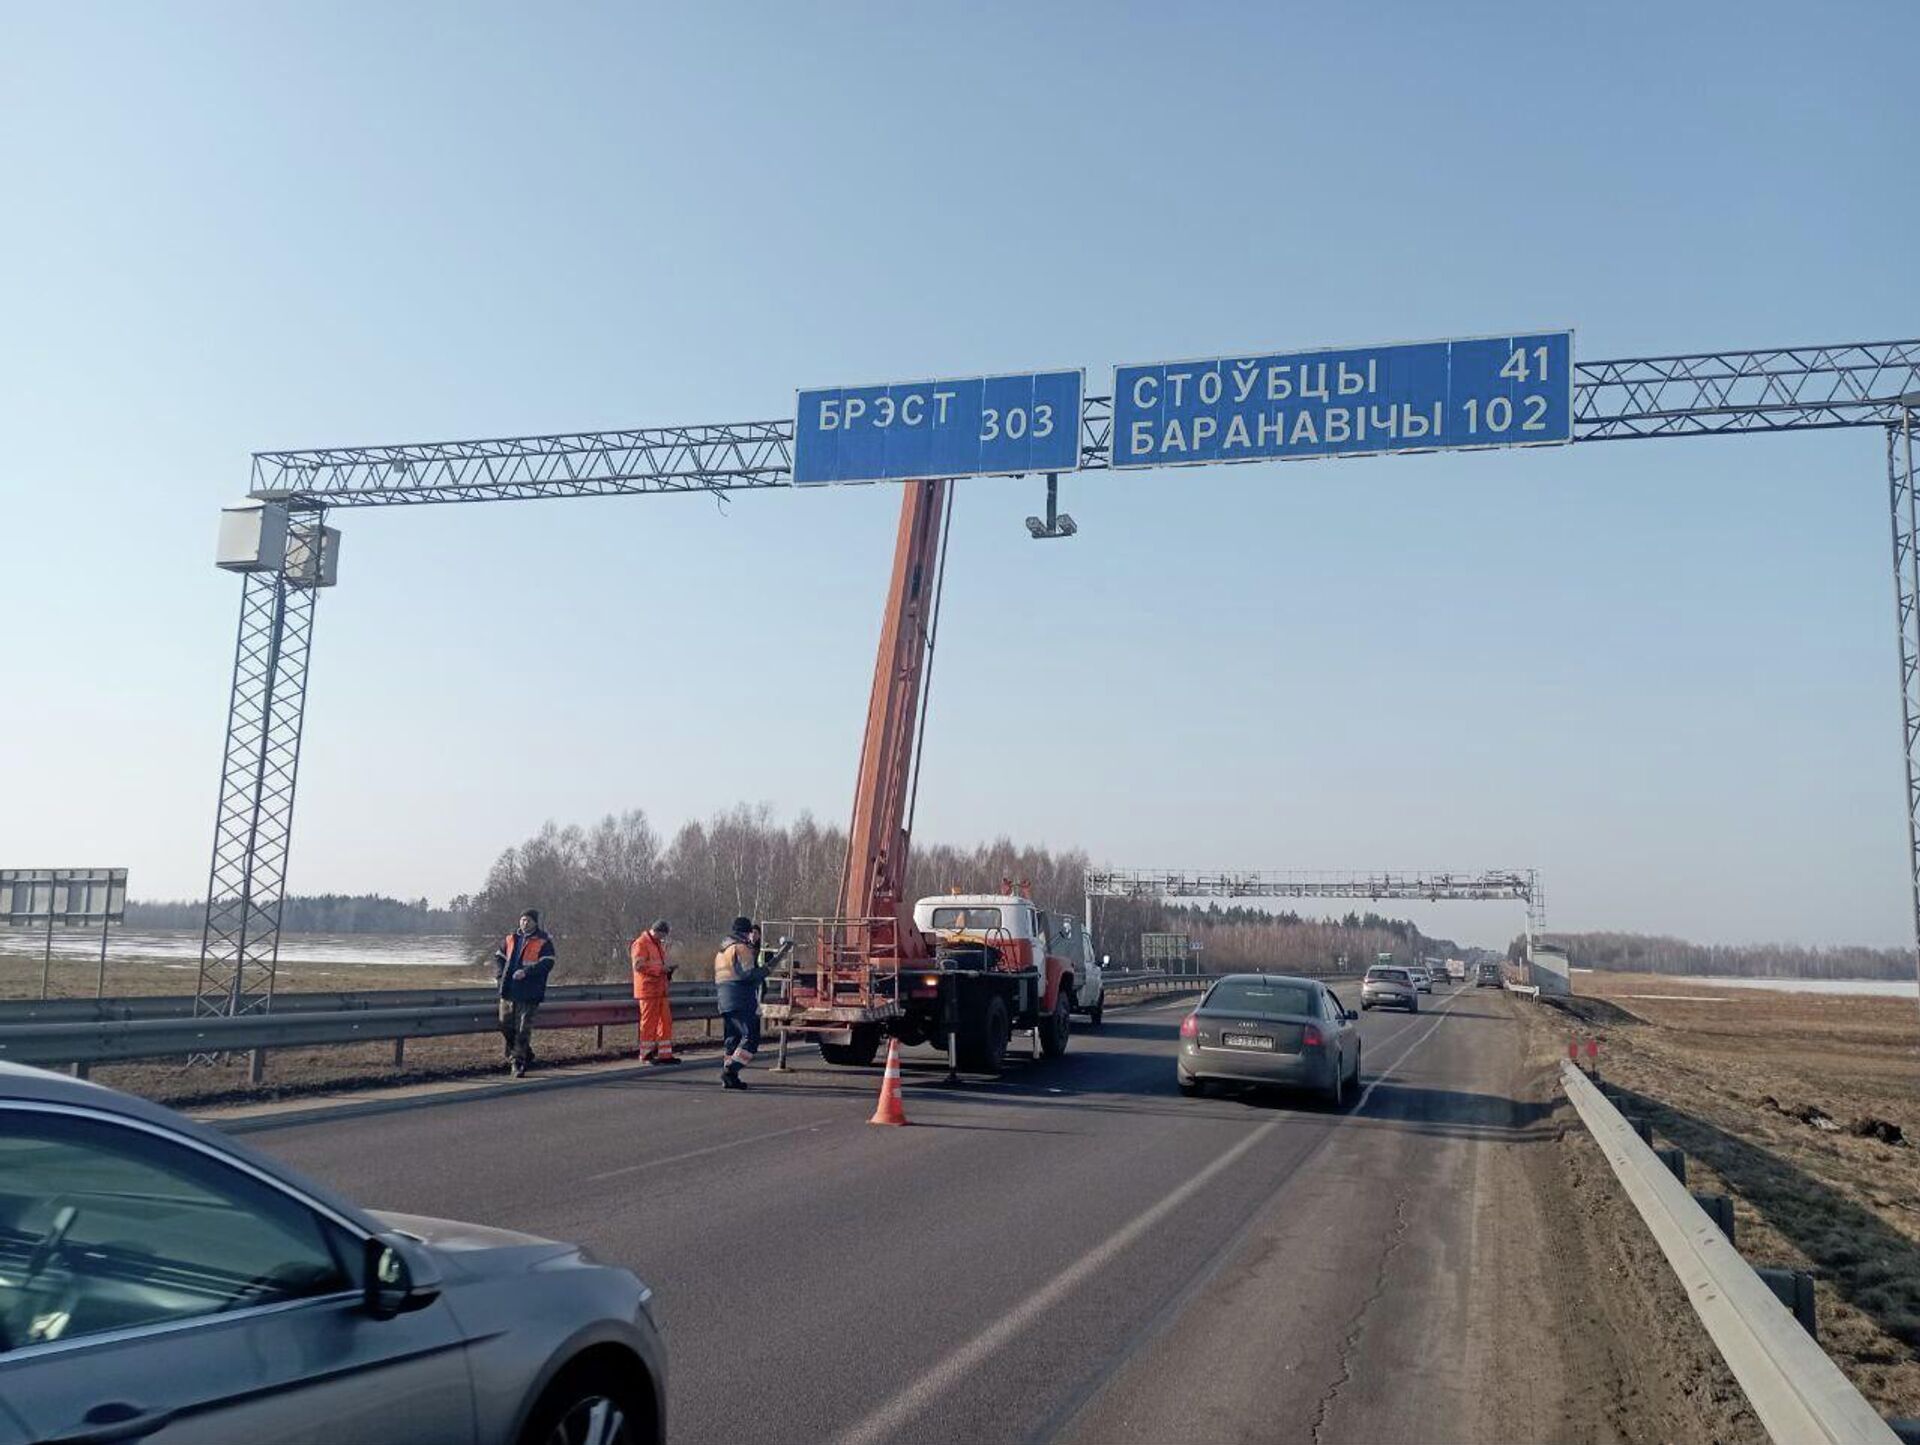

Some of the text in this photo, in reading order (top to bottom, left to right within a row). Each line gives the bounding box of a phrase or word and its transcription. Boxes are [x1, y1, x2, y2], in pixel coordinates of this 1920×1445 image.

[1133, 346, 1548, 408] СТОЎБЦЫ 41
[819, 392, 1054, 441] БРЭСТ 303
[1131, 395, 1547, 455] БАРАНАВІЧЫ 102
